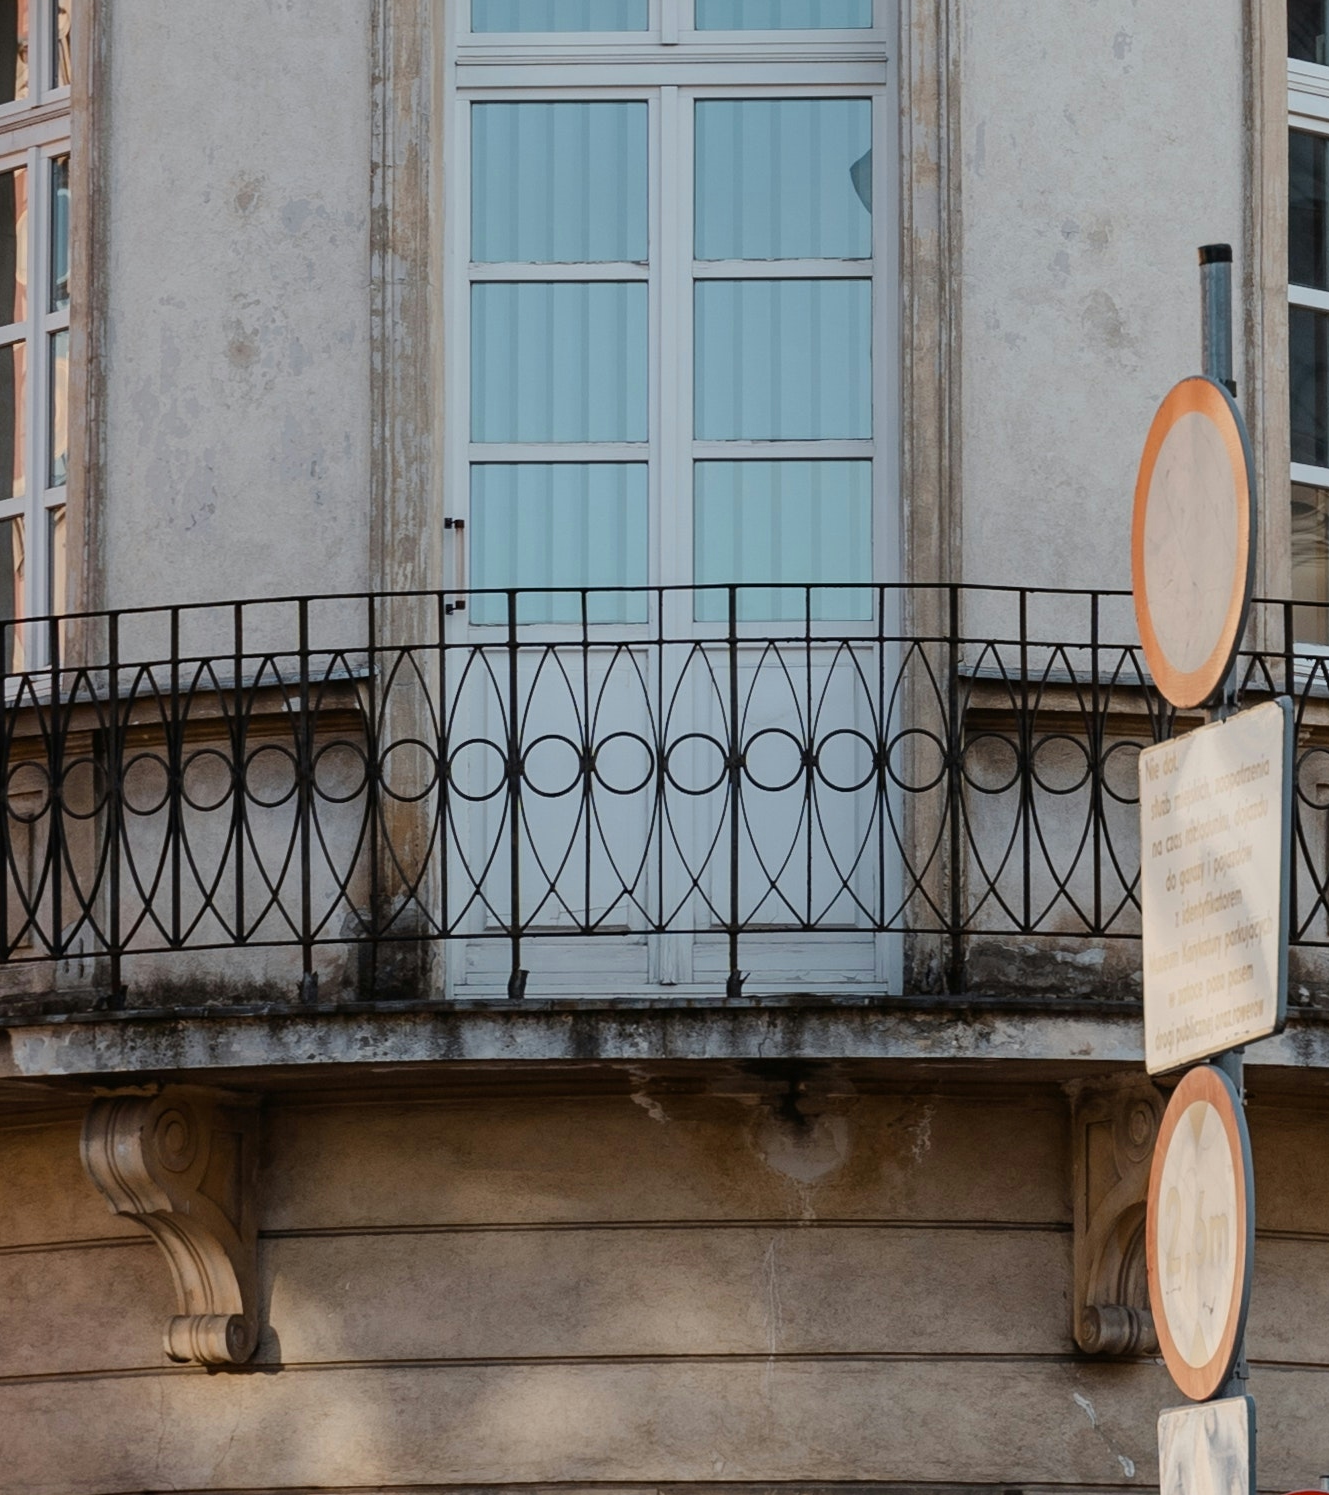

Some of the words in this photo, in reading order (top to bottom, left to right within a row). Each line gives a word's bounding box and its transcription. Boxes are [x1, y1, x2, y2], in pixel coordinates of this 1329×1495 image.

[1145, 758, 1159, 781] Nie
[1152, 840, 1162, 857] na
[1165, 833, 1182, 853] czas
[1165, 869, 1176, 892] do
[1154, 1023, 1174, 1052] drogi
